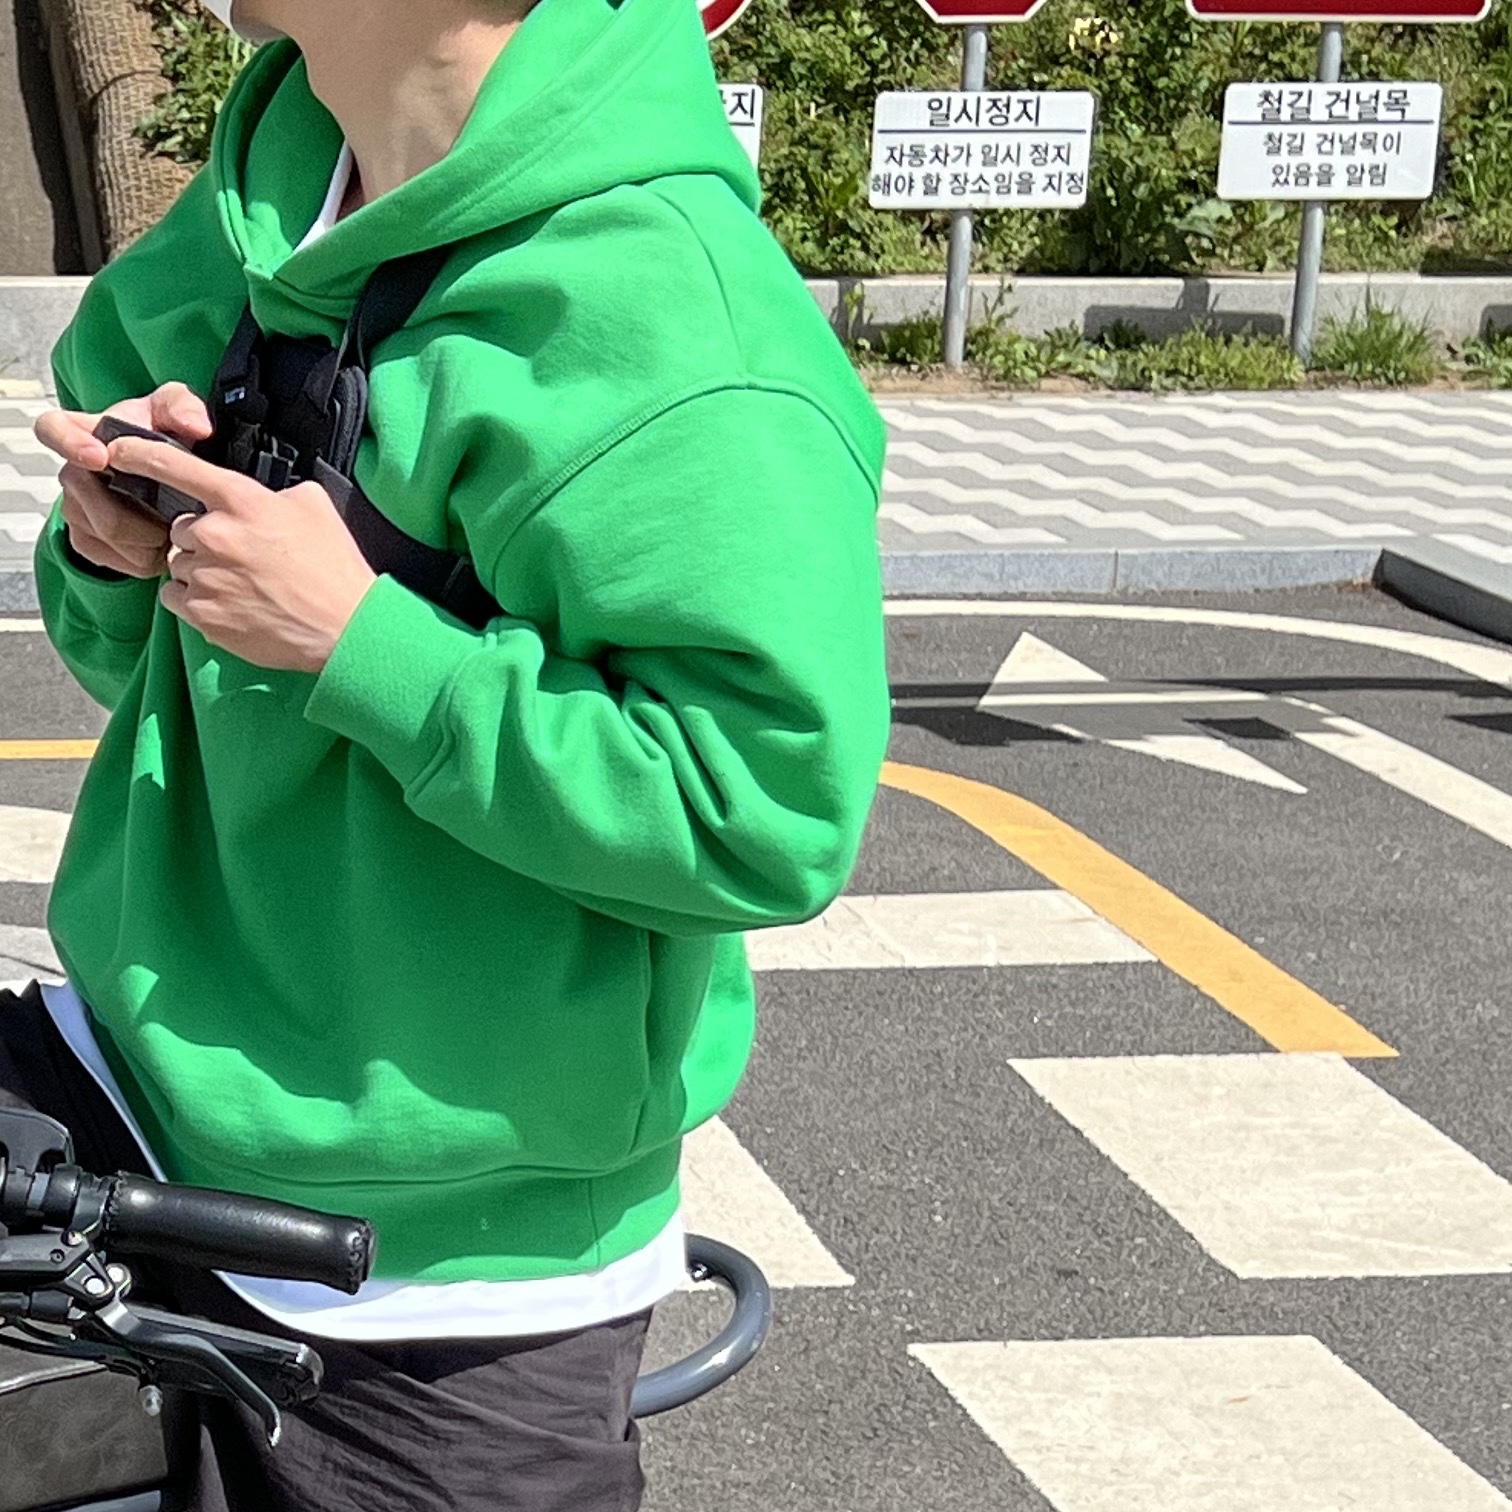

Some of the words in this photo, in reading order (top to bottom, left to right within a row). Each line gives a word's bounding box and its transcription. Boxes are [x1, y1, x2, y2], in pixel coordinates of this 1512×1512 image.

[927, 95, 1041, 127] 일시정지
[1257, 89, 1313, 121] 철길
[1325, 89, 1410, 121] 건널목
[885, 142, 972, 168] 자동차가
[981, 142, 1022, 168] 일시
[1029, 142, 1071, 167] 정지
[1263, 132, 1305, 156] 철길
[1316, 131, 1402, 156] 건널목이
[872, 172, 915, 197] 해야
[922, 172, 942, 197] 할
[949, 171, 1036, 196] 장소임을
[1042, 171, 1085, 196] 지정
[1271, 162, 1335, 188] 있음을
[1346, 162, 1388, 188] 알림
